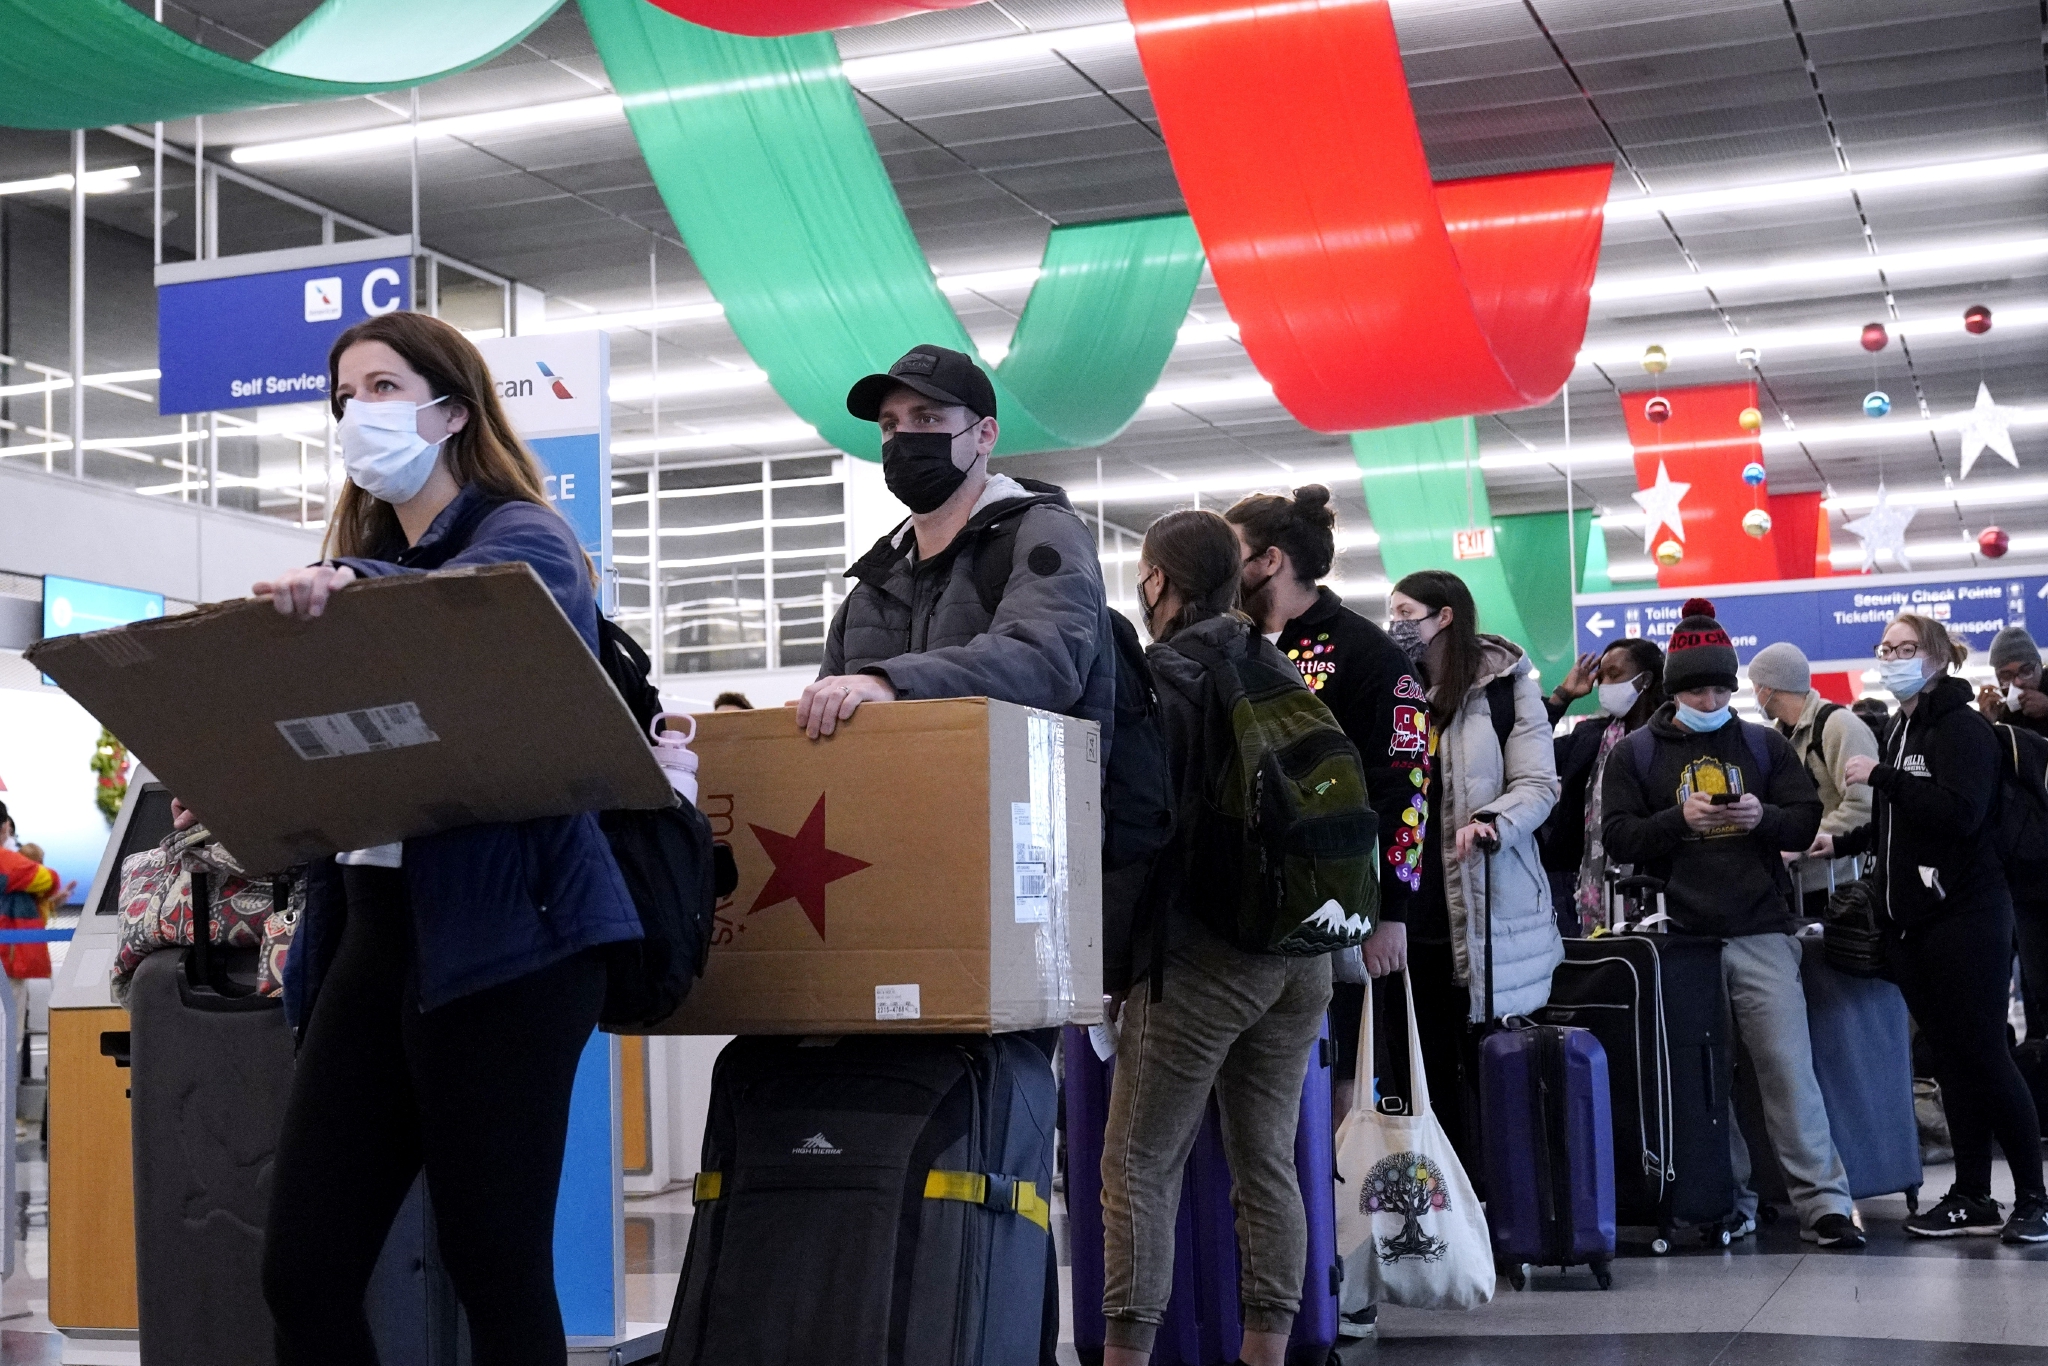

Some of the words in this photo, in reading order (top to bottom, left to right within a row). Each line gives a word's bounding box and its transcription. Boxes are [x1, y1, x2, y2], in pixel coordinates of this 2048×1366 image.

[361, 267, 400, 318] C
[231, 377, 263, 398] Self
[266, 373, 326, 394] Service
[1457, 530, 1486, 552] EXIT
[1854, 591, 1909, 607] Security
[1912, 589, 1955, 603] Check
[1958, 585, 2002, 600] Points
[1833, 609, 1894, 625] Ticketing
